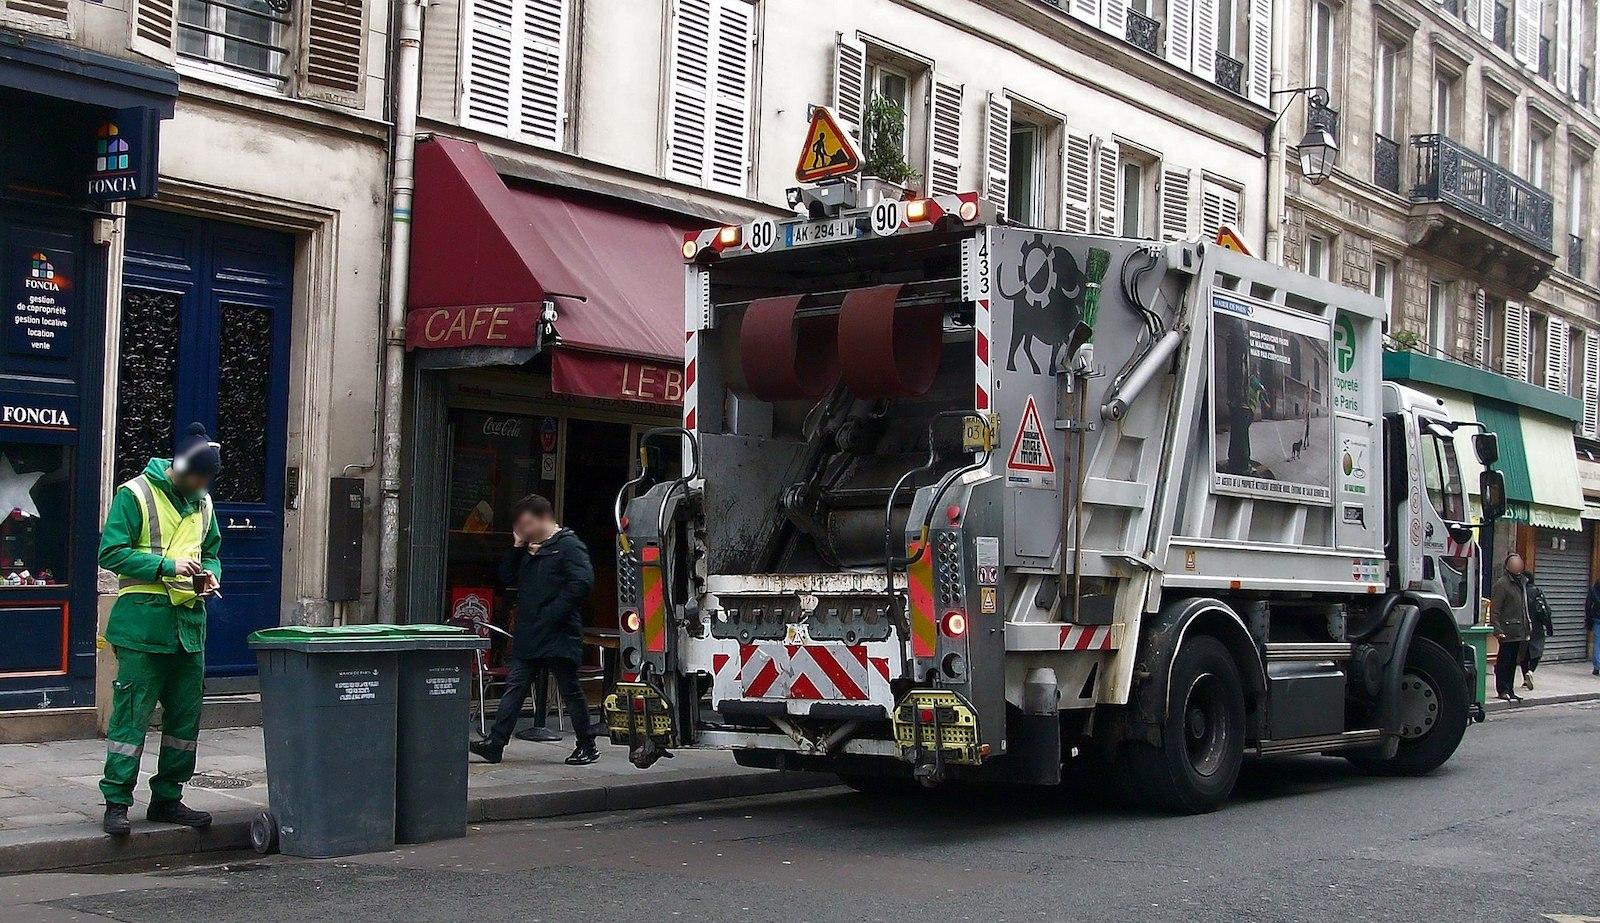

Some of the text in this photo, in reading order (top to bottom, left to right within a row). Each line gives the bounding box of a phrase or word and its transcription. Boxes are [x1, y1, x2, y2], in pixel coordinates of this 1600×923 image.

[88, 176, 136, 194] FONCIA
[876, 203, 897, 231] 90
[752, 221, 771, 248] 80
[25, 279, 60, 292] FONCIA
[29, 295, 55, 305] gestion
[16, 302, 67, 315] de copropriété
[15, 315, 68, 327] gestion locative
[425, 307, 514, 342] CAFE
[27, 328, 54, 338] location
[31, 341, 51, 350] vente
[622, 363, 684, 401] LE B
[1333, 377, 1359, 392] ropreté
[1340, 395, 1359, 411] Paris
[3, 405, 70, 426] FONCIA
[1021, 450, 1042, 465] MORT
